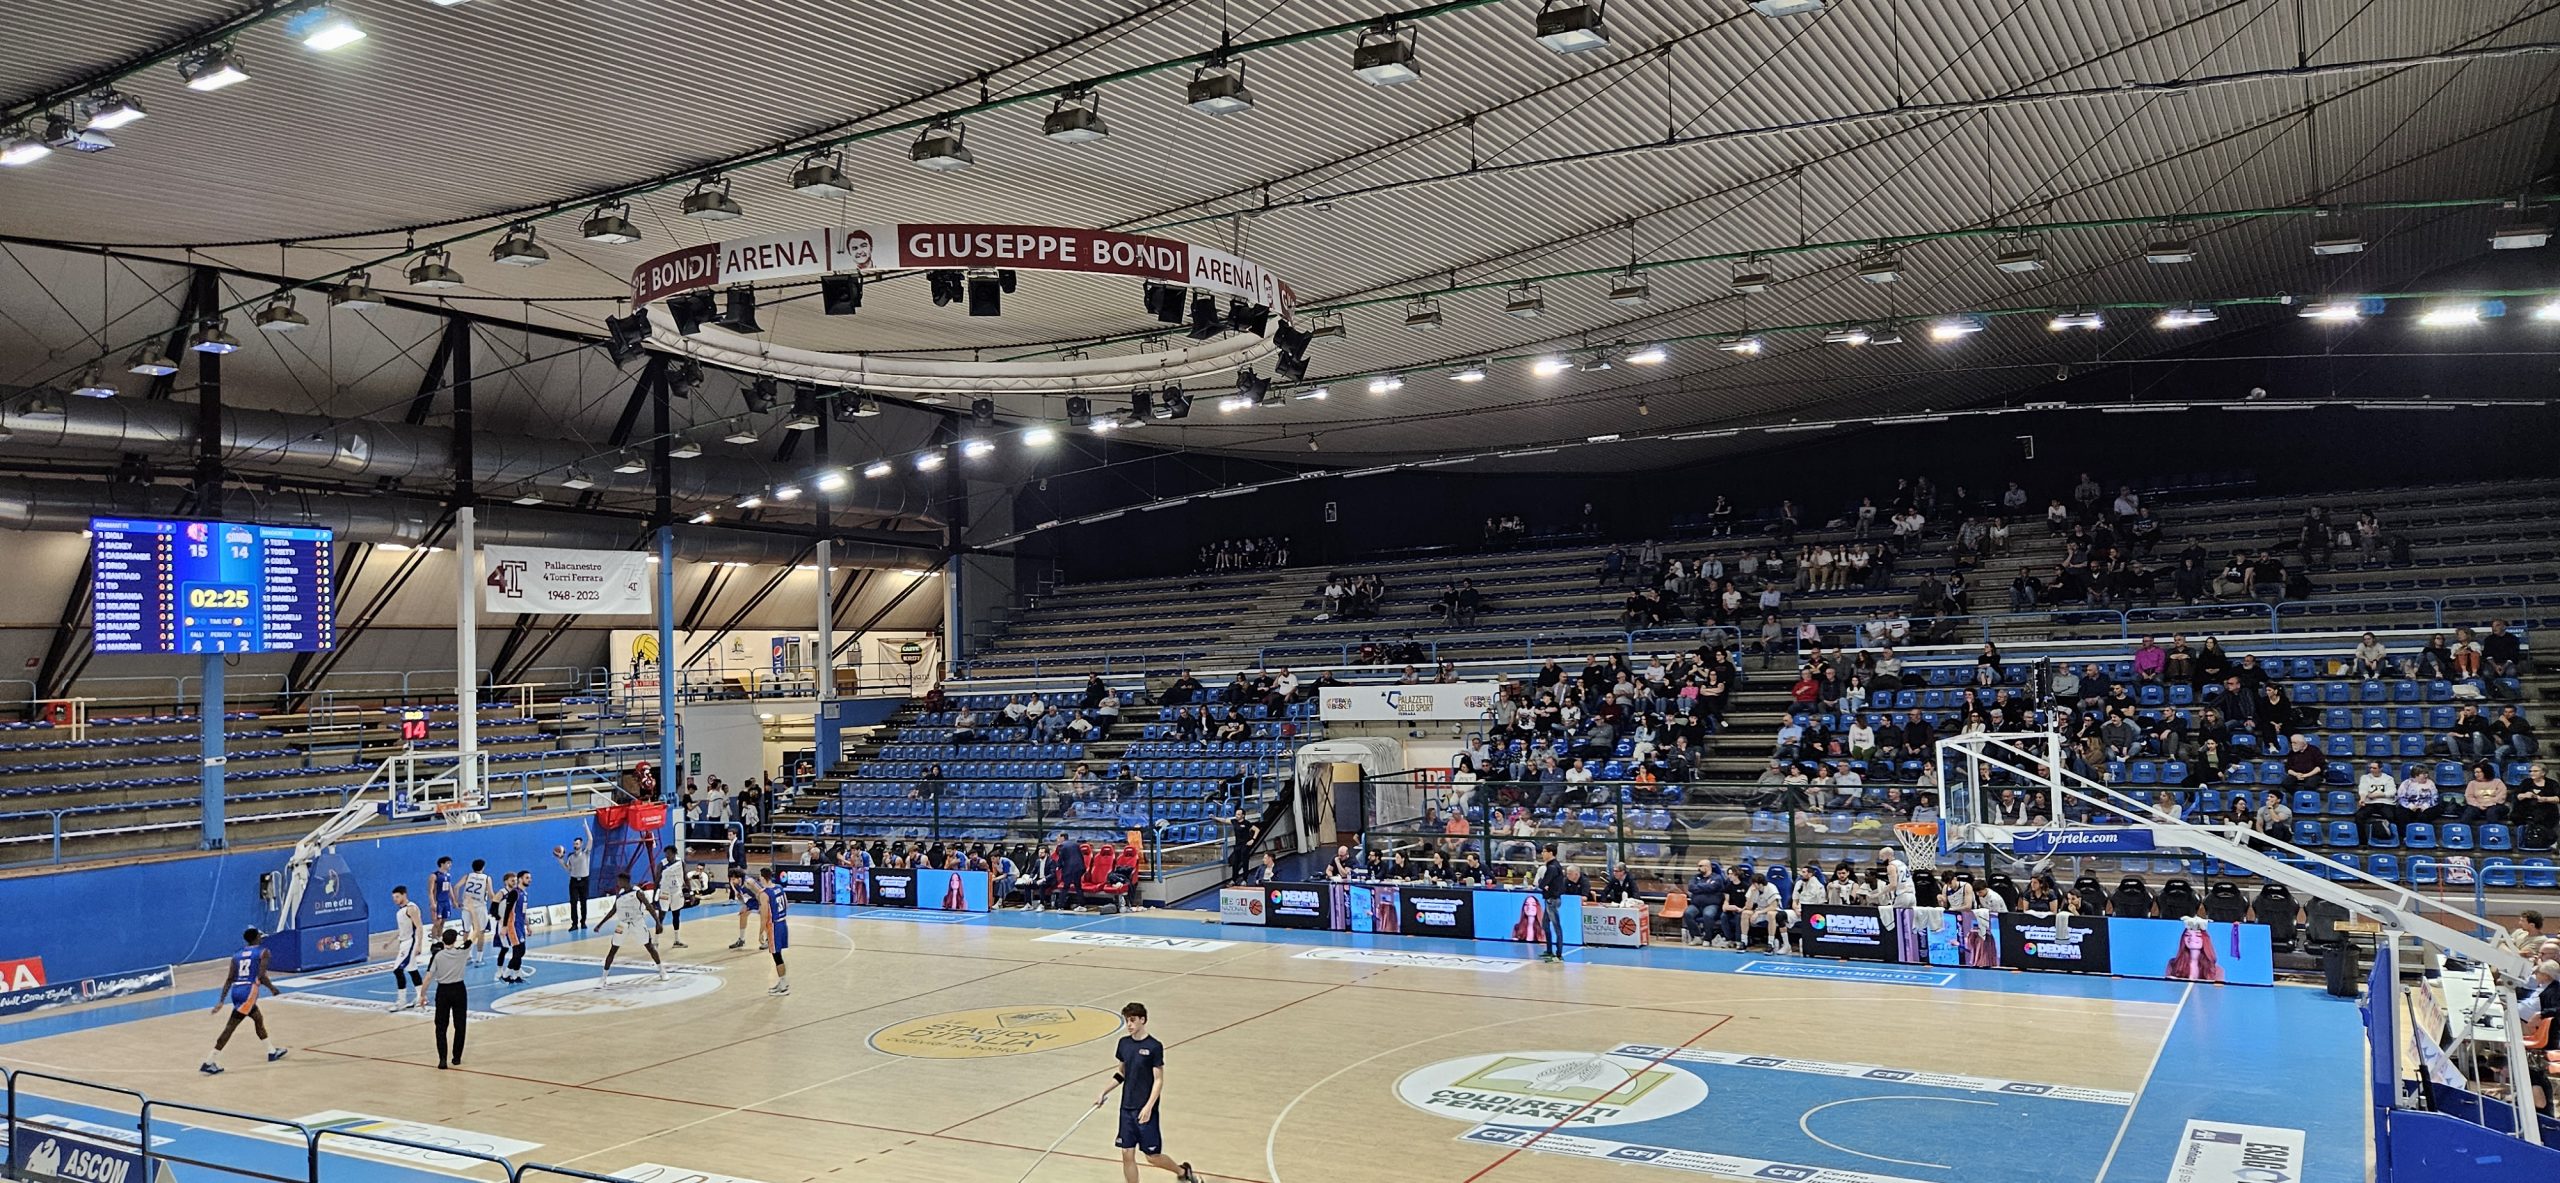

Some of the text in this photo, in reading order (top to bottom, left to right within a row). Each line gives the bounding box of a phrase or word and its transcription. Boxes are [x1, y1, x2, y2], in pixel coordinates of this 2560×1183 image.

[725, 239, 818, 274] ARENA
[908, 233, 1183, 273] GIUSEPPE BONDI
[652, 253, 712, 291] BONDI
[1195, 256, 1254, 292] ARENA
[189, 544, 208, 557] 15
[231, 546, 249, 558] 14
[545, 561, 602, 571] Pallacanestro
[572, 574, 604, 582] Ferrara
[190, 589, 249, 608] 02:25
[191, 640, 202, 652] 4
[216, 640, 225, 652] 1
[240, 640, 250, 652] 2
[1398, 695, 1433, 704] PALAZZETTO
[1398, 703, 1433, 712] DELLO SPORT
[403, 721, 426, 739] 14
[2048, 832, 2118, 844] bertele.com
[466, 881, 483, 895] 22
[1282, 890, 1319, 902] DEDEM
[1826, 914, 1880, 930] DEDEM
[2037, 943, 2080, 955] DEDEM
[925, 1023, 1060, 1041] STAGIONI
[903, 1029, 1034, 1048] D'ITALIA
[1746, 1057, 1775, 1066] CFI
[1872, 1070, 1905, 1080] CFI
[2009, 1084, 2043, 1093] CFI
[1432, 1089, 1621, 1118] COLDIRETTI
[1424, 1097, 1597, 1125] FERRARA
[1481, 1131, 1515, 1140] CFI
[1620, 1148, 1656, 1159] CFI
[1672, 1151, 1714, 1160] Centro
[63, 1149, 130, 1183] ASCOM
[1663, 1155, 1741, 1168] Formazione
[1768, 1167, 1808, 1179] CFI
[1823, 1170, 1869, 1180] Centro
